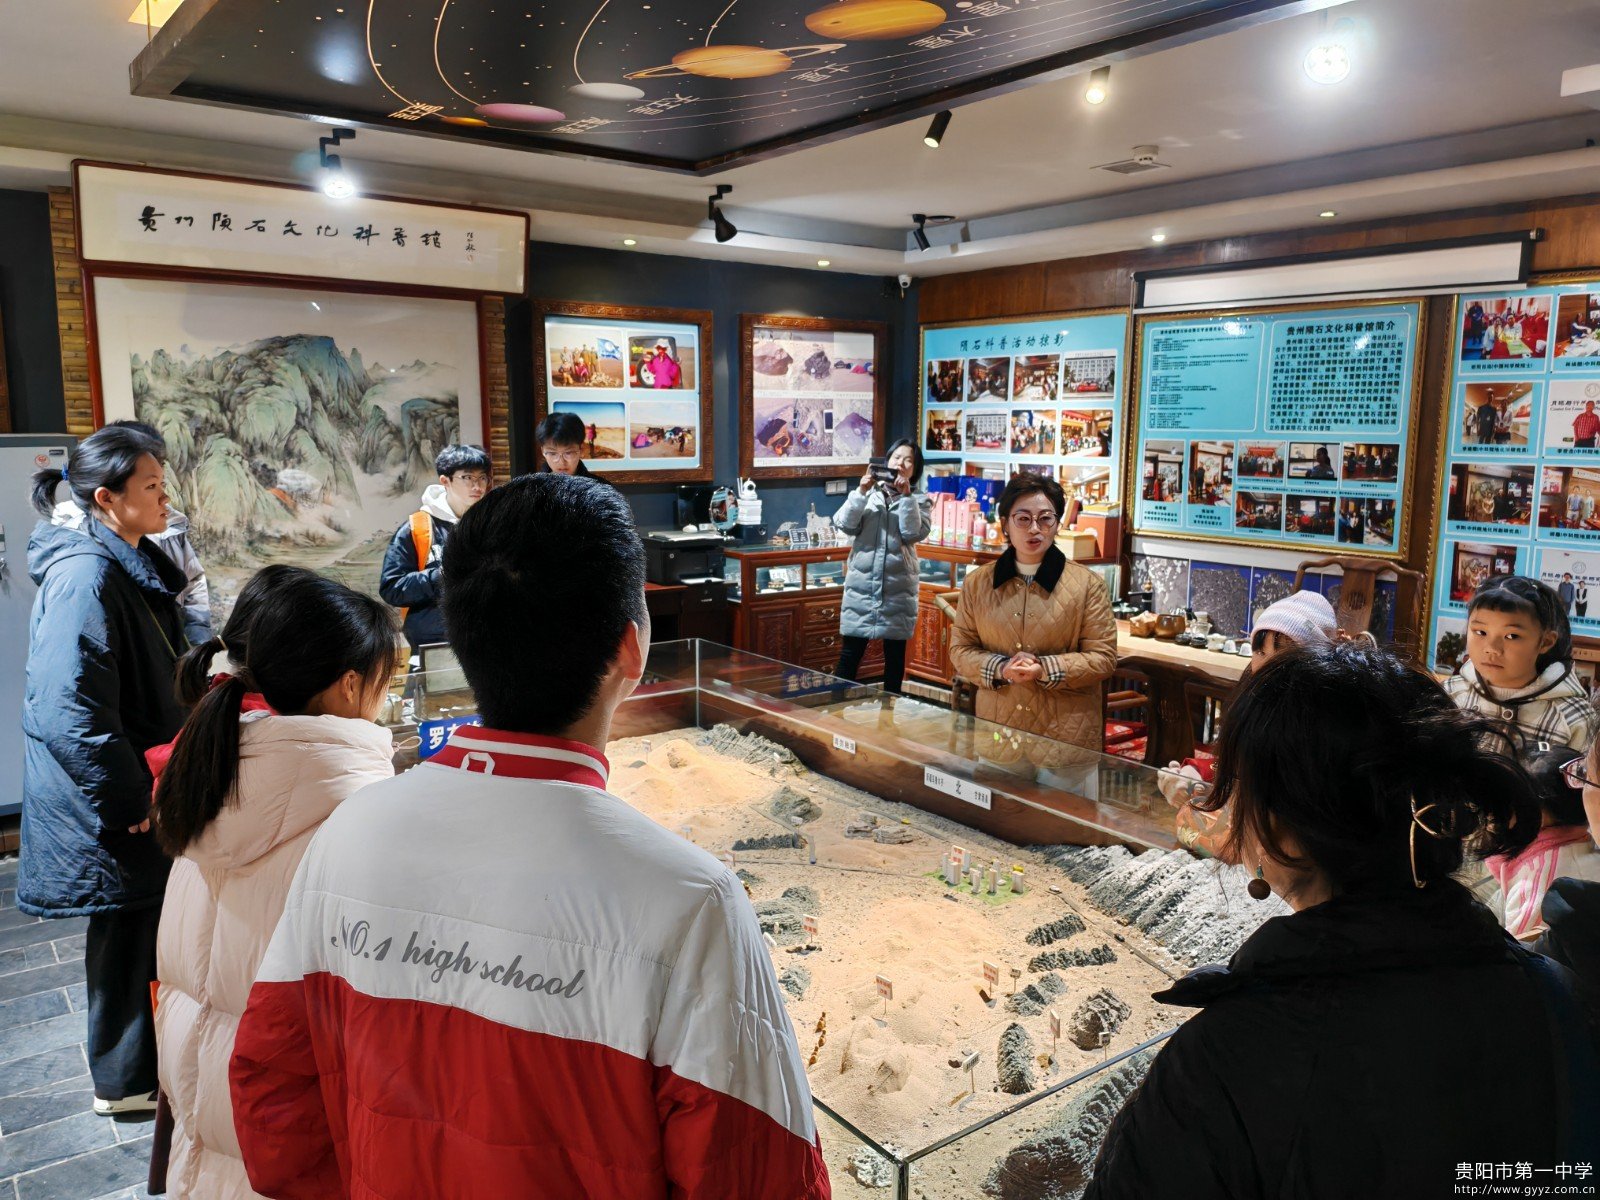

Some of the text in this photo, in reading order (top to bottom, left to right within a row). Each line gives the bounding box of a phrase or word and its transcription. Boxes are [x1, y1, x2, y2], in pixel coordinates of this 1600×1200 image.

[907, 25, 982, 50] 木星
[790, 63, 851, 83] 土星
[627, 93, 701, 116] 天王星
[1287, 320, 1396, 336] 贵州陨石文化科普馆简介
[960, 333, 1065, 352] 陨石科普活动掠影
[330, 915, 586, 999] NO.1 high school
